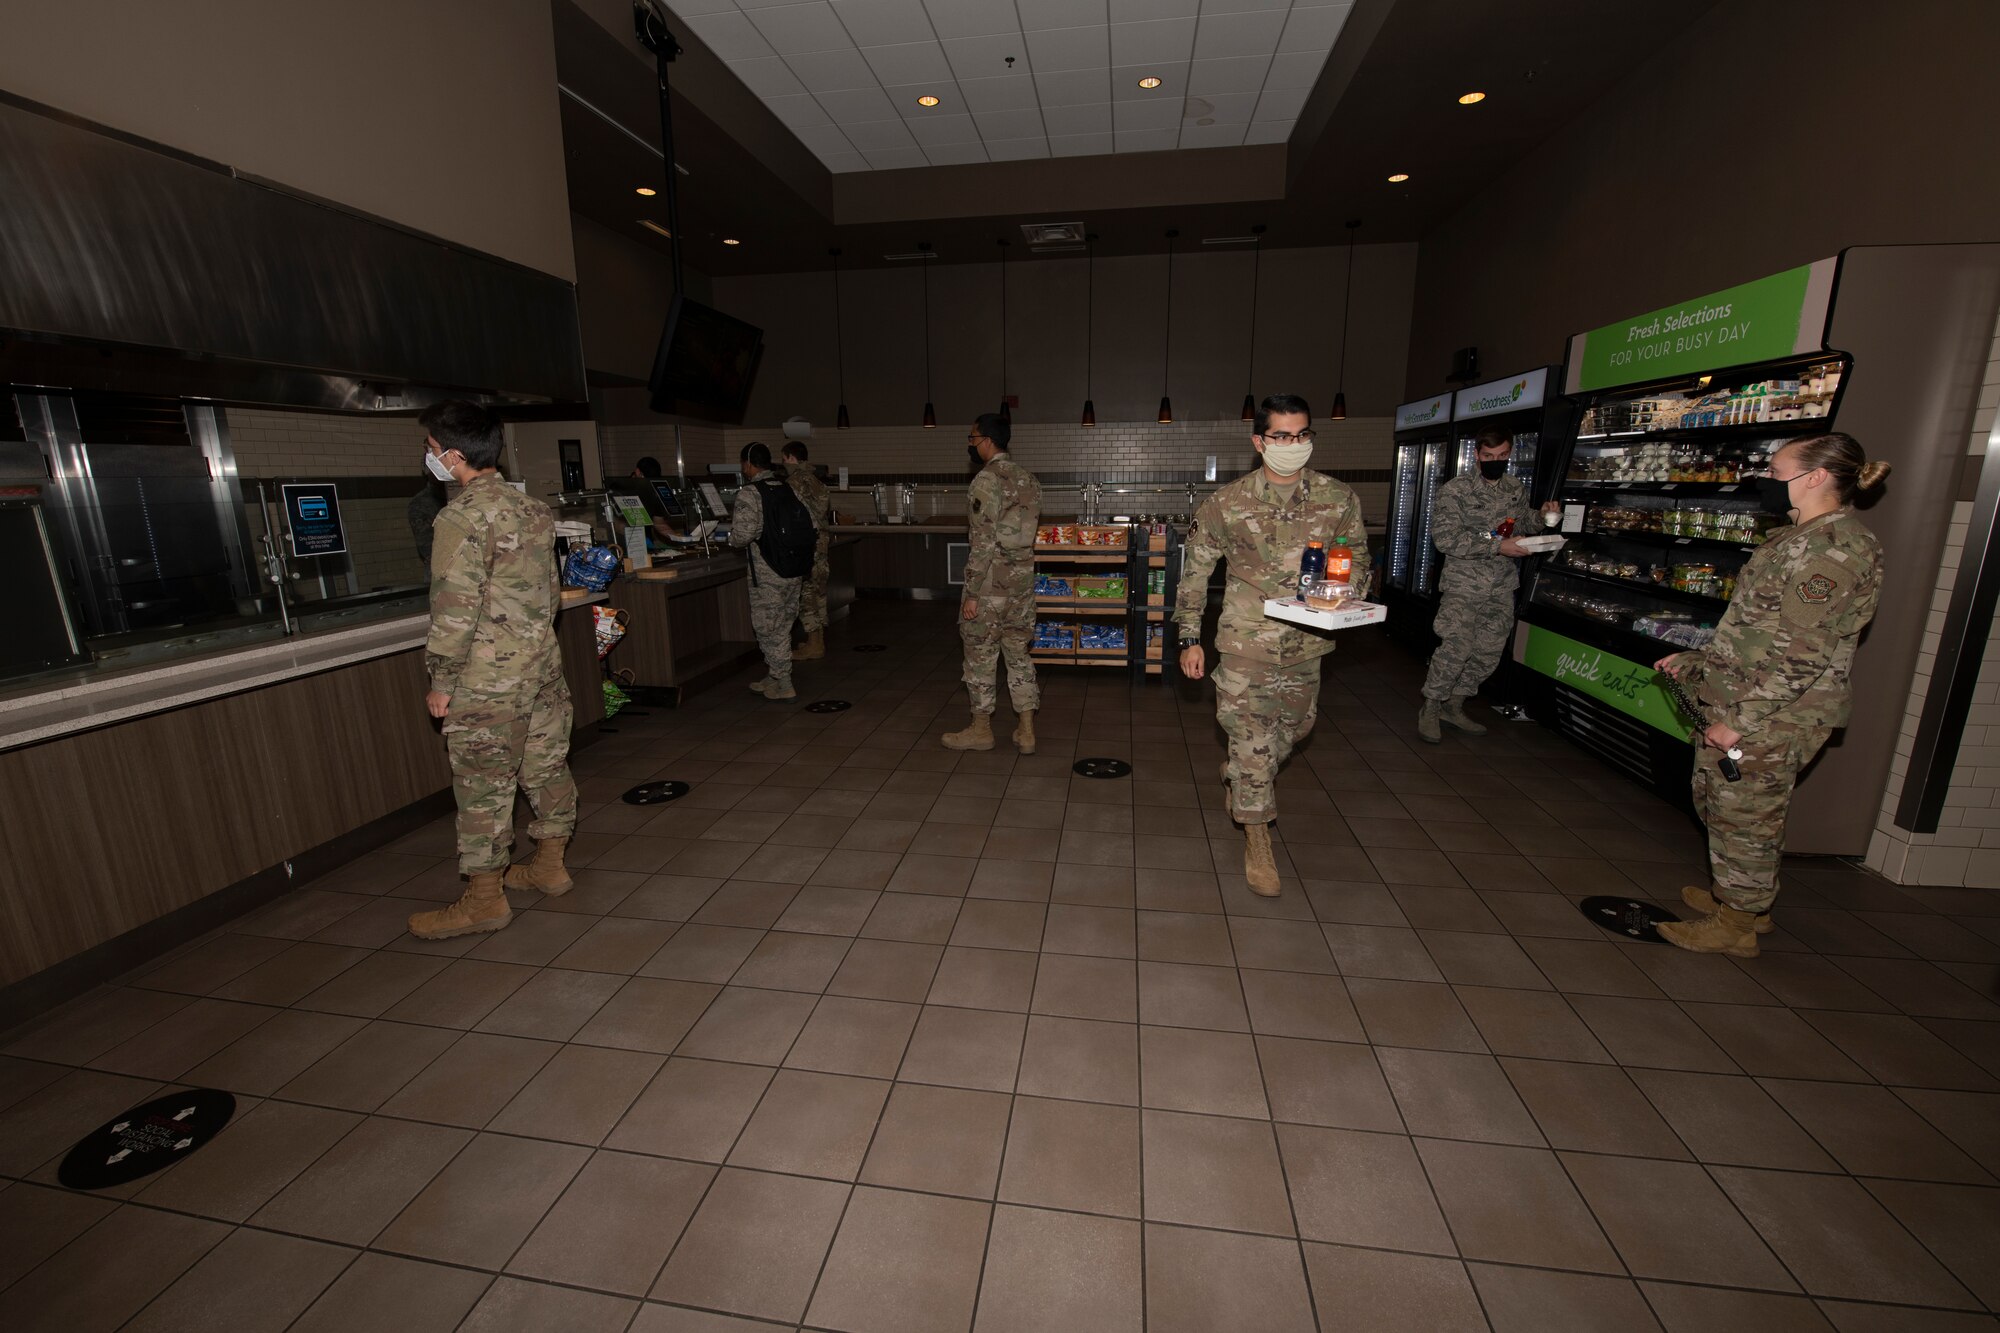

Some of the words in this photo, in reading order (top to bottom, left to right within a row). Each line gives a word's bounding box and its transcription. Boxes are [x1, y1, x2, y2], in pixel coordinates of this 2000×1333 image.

[1610, 350, 1632, 366] FOR
[1638, 341, 1670, 360] YOUR
[1676, 330, 1713, 353] BUSY
[1719, 321, 1751, 343] DAY
[1627, 318, 1660, 342] Fresh
[1663, 304, 1732, 333] Selections
[1556, 653, 1601, 681] quick
[1602, 668, 1639, 699] eats
